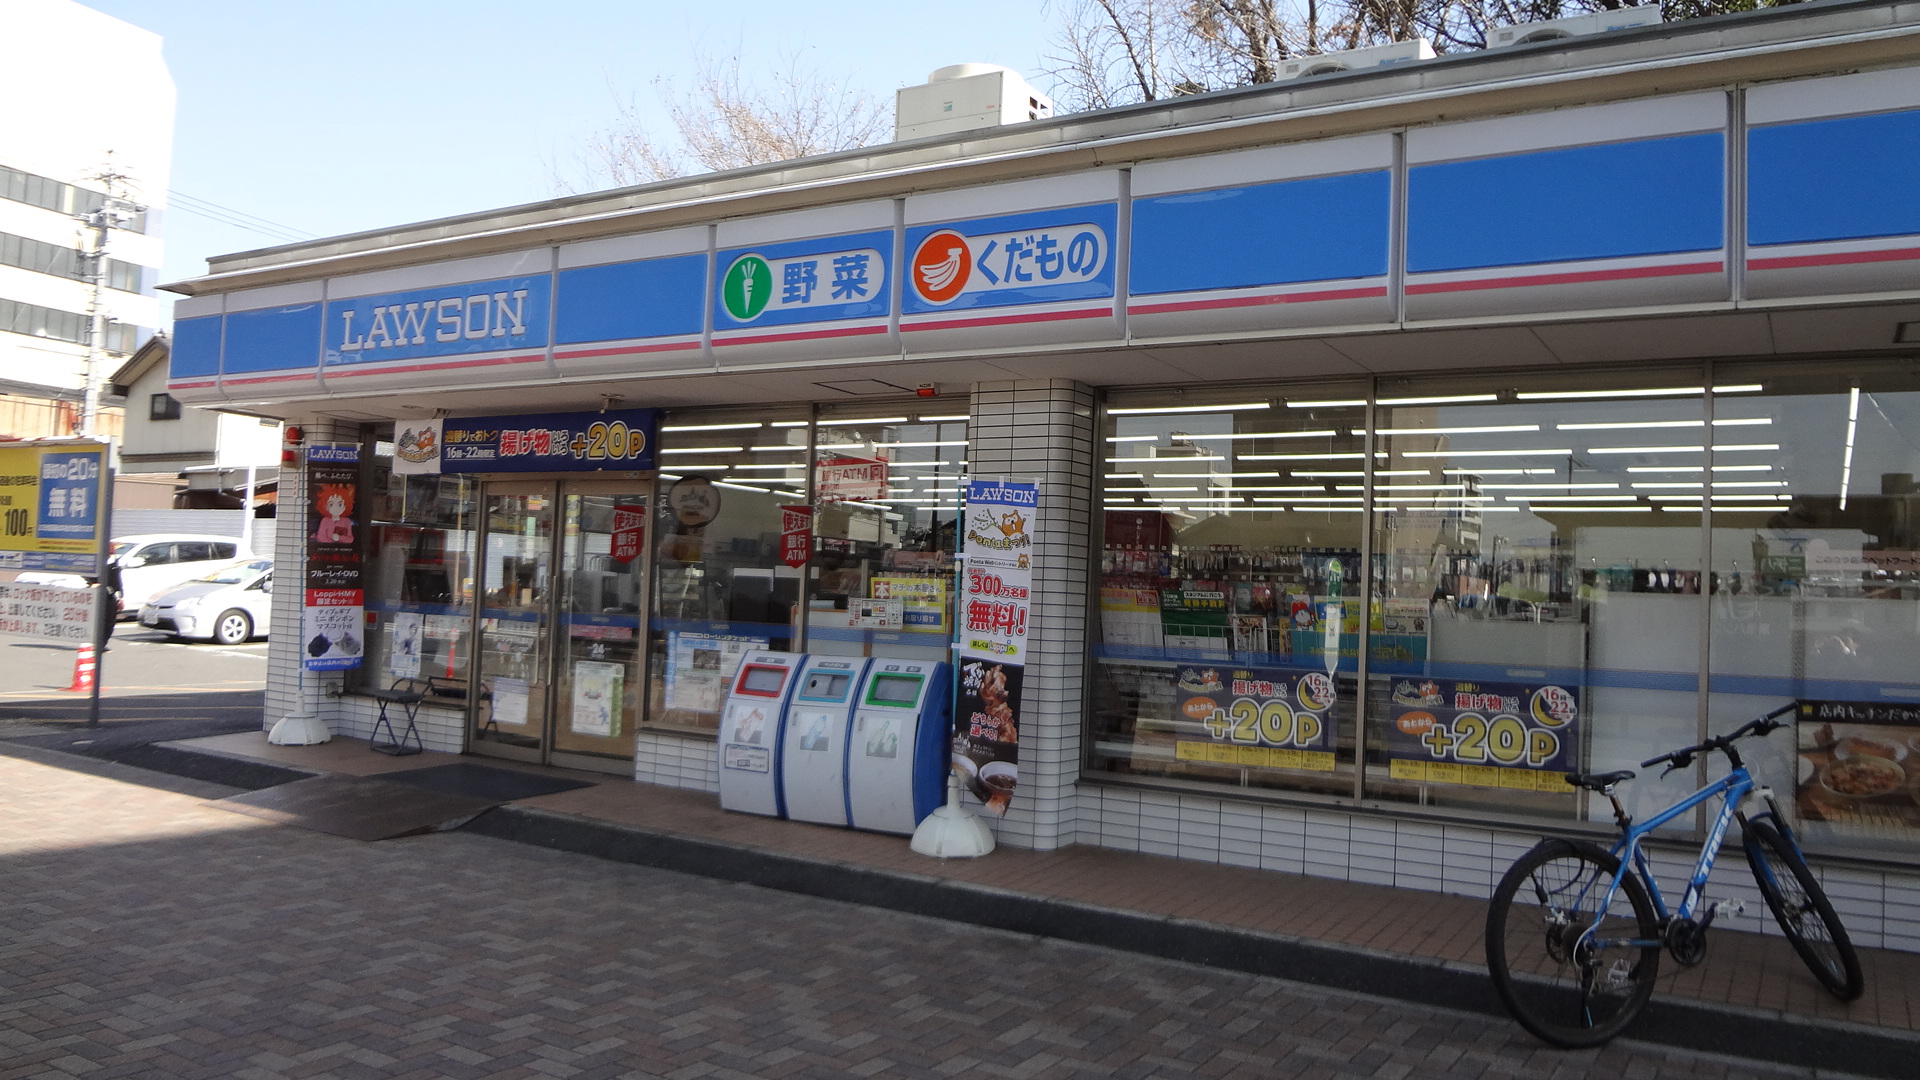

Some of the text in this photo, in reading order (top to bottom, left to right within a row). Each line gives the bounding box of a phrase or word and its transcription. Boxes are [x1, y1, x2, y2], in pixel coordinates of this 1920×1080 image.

[977, 231, 1100, 286] くだもの
[782, 254, 870, 304] 野菜
[341, 289, 528, 352] LAWSON
[500, 429, 553, 460] 揚げ物
[310, 448, 358, 460] LAWSON
[822, 468, 868, 482] 銀行ATM
[48, 487, 88, 517] 無料
[970, 487, 1036, 504] LAWSON
[617, 533, 637, 546] 銀行
[787, 534, 807, 547] 銀行
[616, 546, 637, 557] ATM
[786, 547, 807, 559] ATM
[876, 582, 889, 598] 本
[970, 574, 1028, 598] 300万名様
[968, 599, 1026, 635] 無料!
[1233, 680, 1272, 697] 揚げ物
[1455, 693, 1502, 711] 揚げ物
[1698, 803, 1734, 879] TREK
